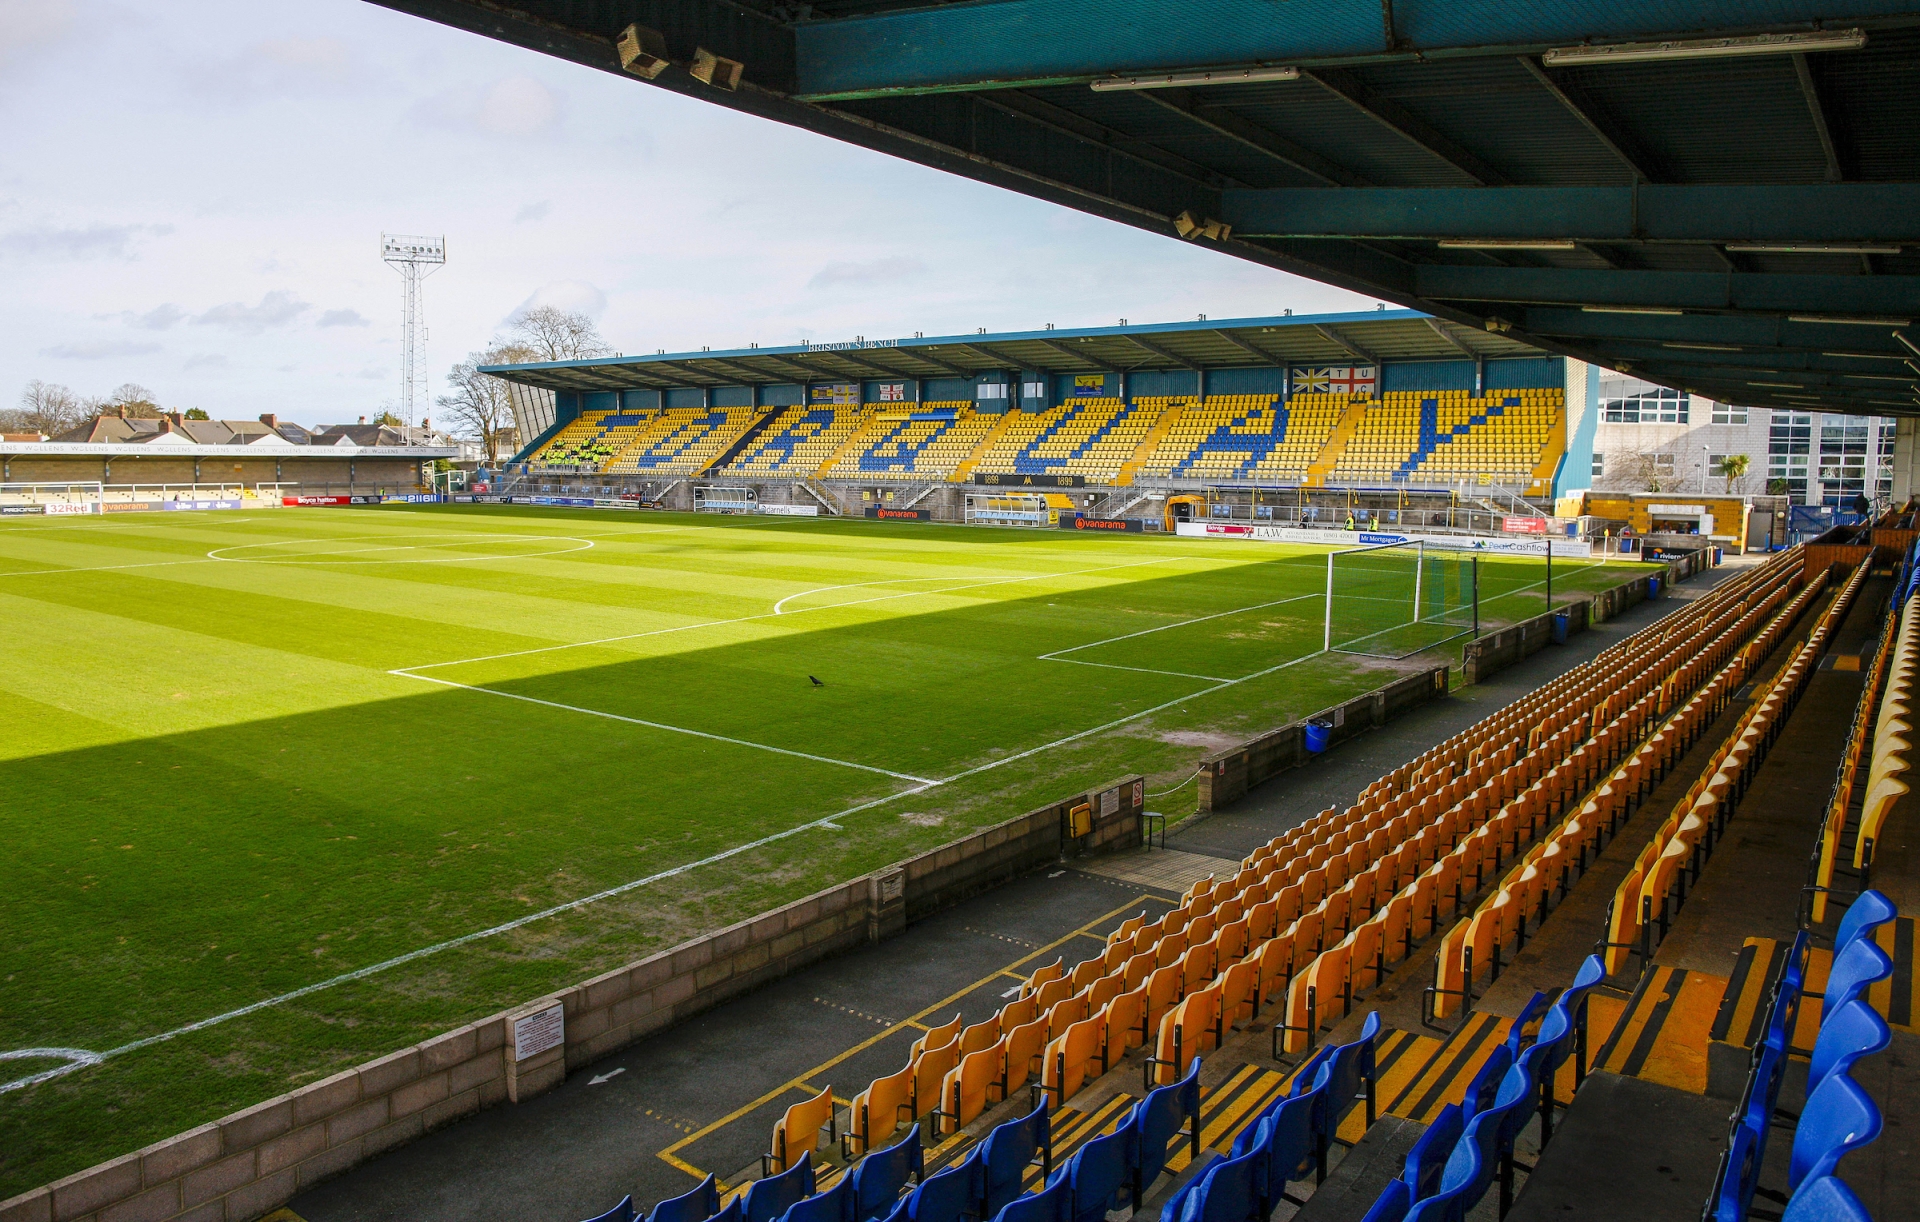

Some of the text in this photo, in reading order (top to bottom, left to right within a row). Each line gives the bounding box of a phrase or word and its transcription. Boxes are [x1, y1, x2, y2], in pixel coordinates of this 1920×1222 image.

[807, 339, 899, 352] BRISTOW'S BENCH
[1057, 477, 1073, 486] 1899
[50, 504, 88, 513] 32Red
[767, 506, 791, 514] darnells
[886, 510, 918, 519] vanarama
[1085, 520, 1127, 530] vanarama
[1369, 535, 1397, 544] Mortgages
